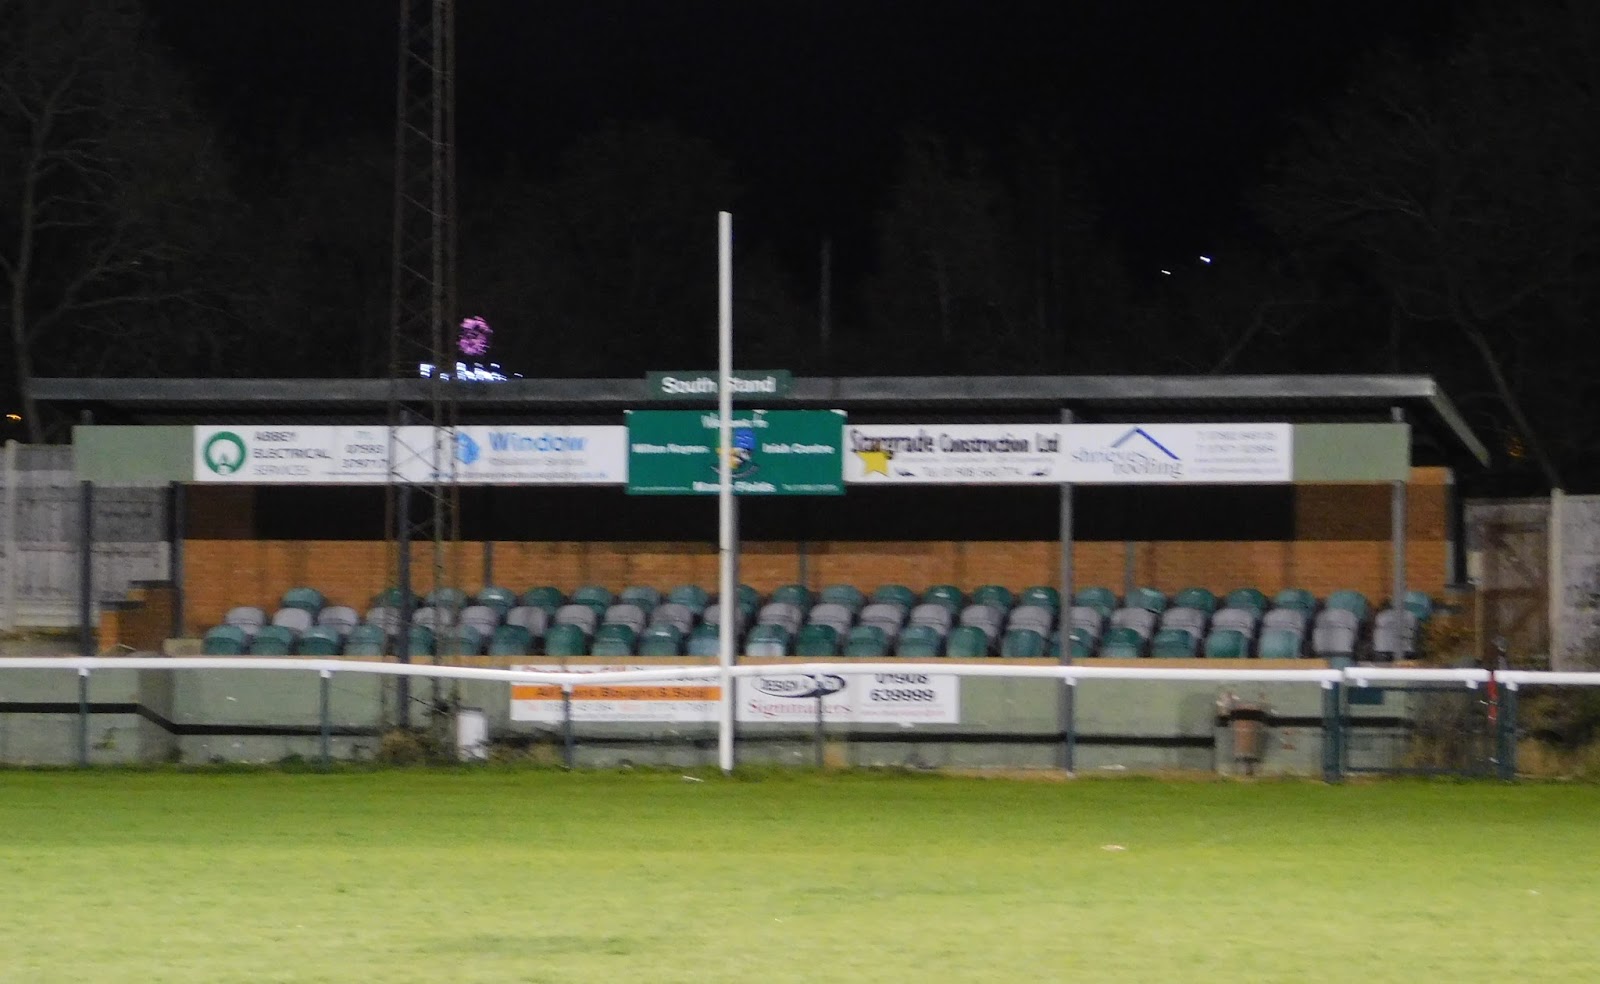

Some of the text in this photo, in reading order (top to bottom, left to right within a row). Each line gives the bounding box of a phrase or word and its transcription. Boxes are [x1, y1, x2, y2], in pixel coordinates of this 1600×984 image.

[661, 376, 718, 393] South
[701, 412, 751, 428] Welome
[253, 431, 296, 442] ABBEY
[488, 431, 586, 451] Window
[631, 443, 710, 455] Milton Keynes
[762, 442, 835, 454] Irish Centre
[850, 428, 1060, 460] Stargrade Construction Ltd
[252, 448, 332, 459] ELECTRICAL
[253, 464, 310, 476] SERVICES
[1113, 459, 1183, 479] roofing
[692, 481, 732, 492] Man
[749, 699, 852, 717] Signmaers
